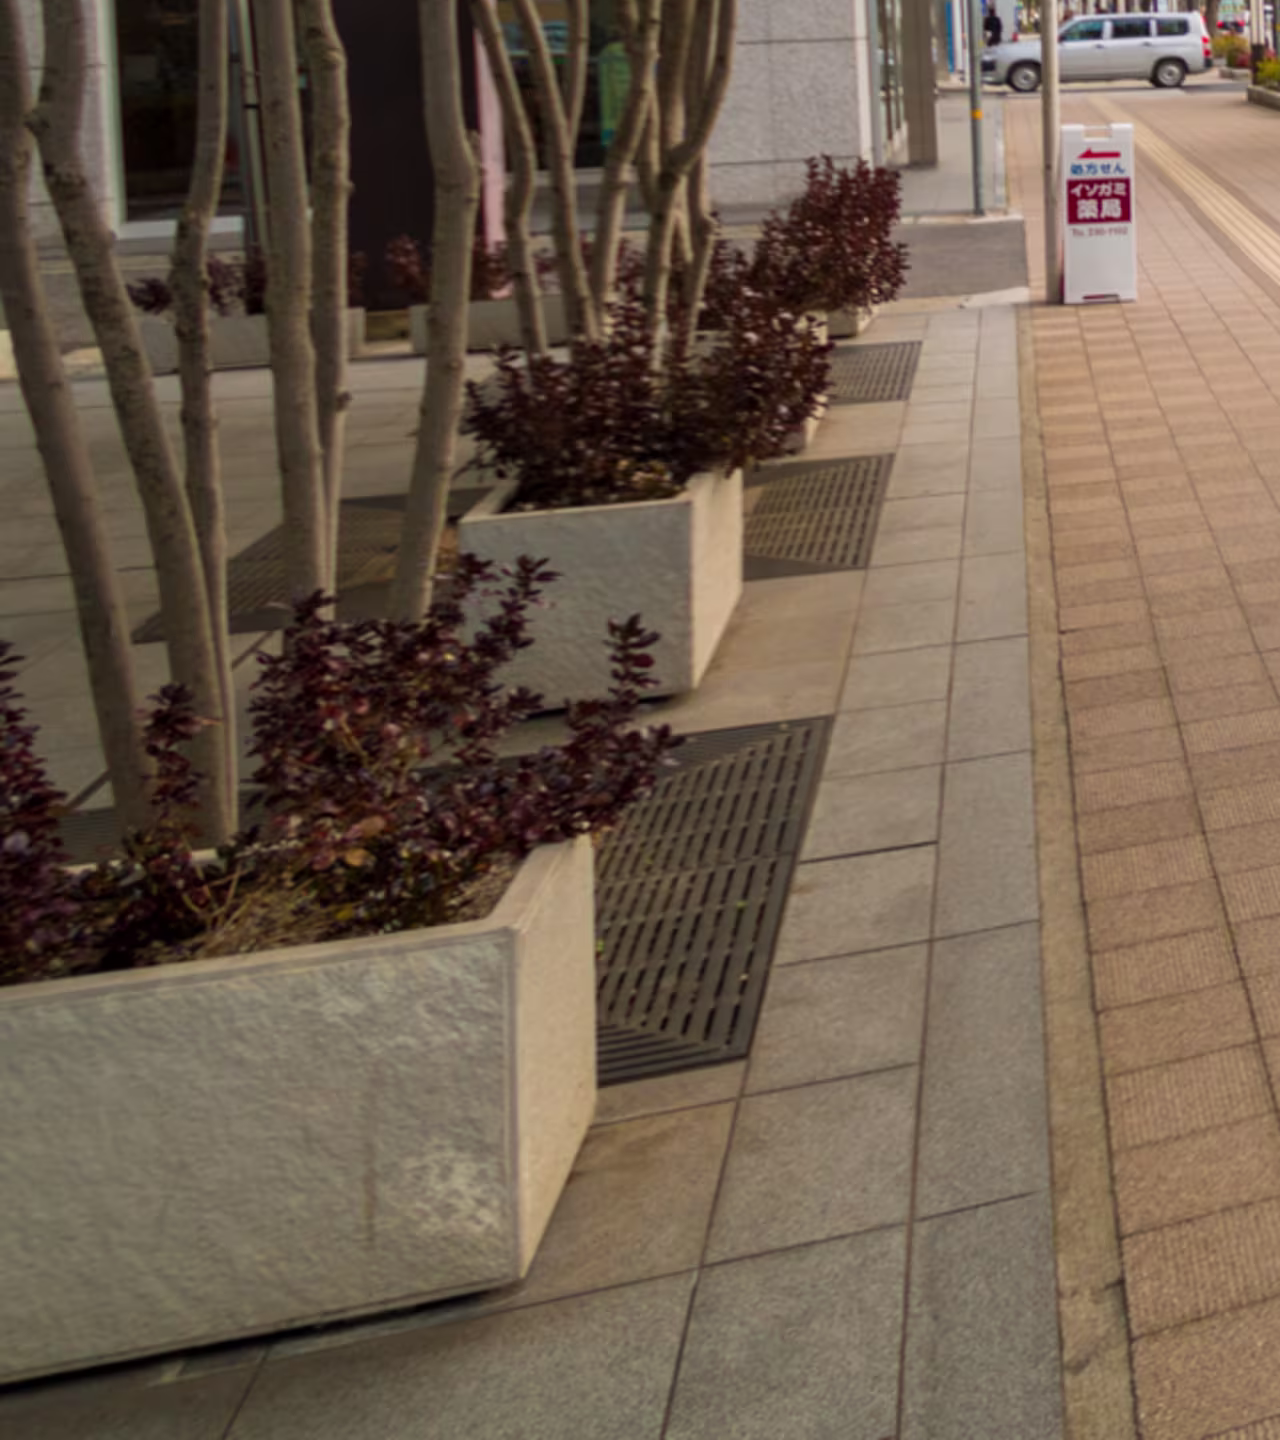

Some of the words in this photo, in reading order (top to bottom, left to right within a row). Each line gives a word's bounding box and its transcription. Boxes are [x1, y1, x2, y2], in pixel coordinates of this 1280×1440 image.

[1070, 162, 1126, 175] 処方せん
[1070, 181, 1127, 197] イソガミ
[1077, 198, 1122, 220] 薬局
